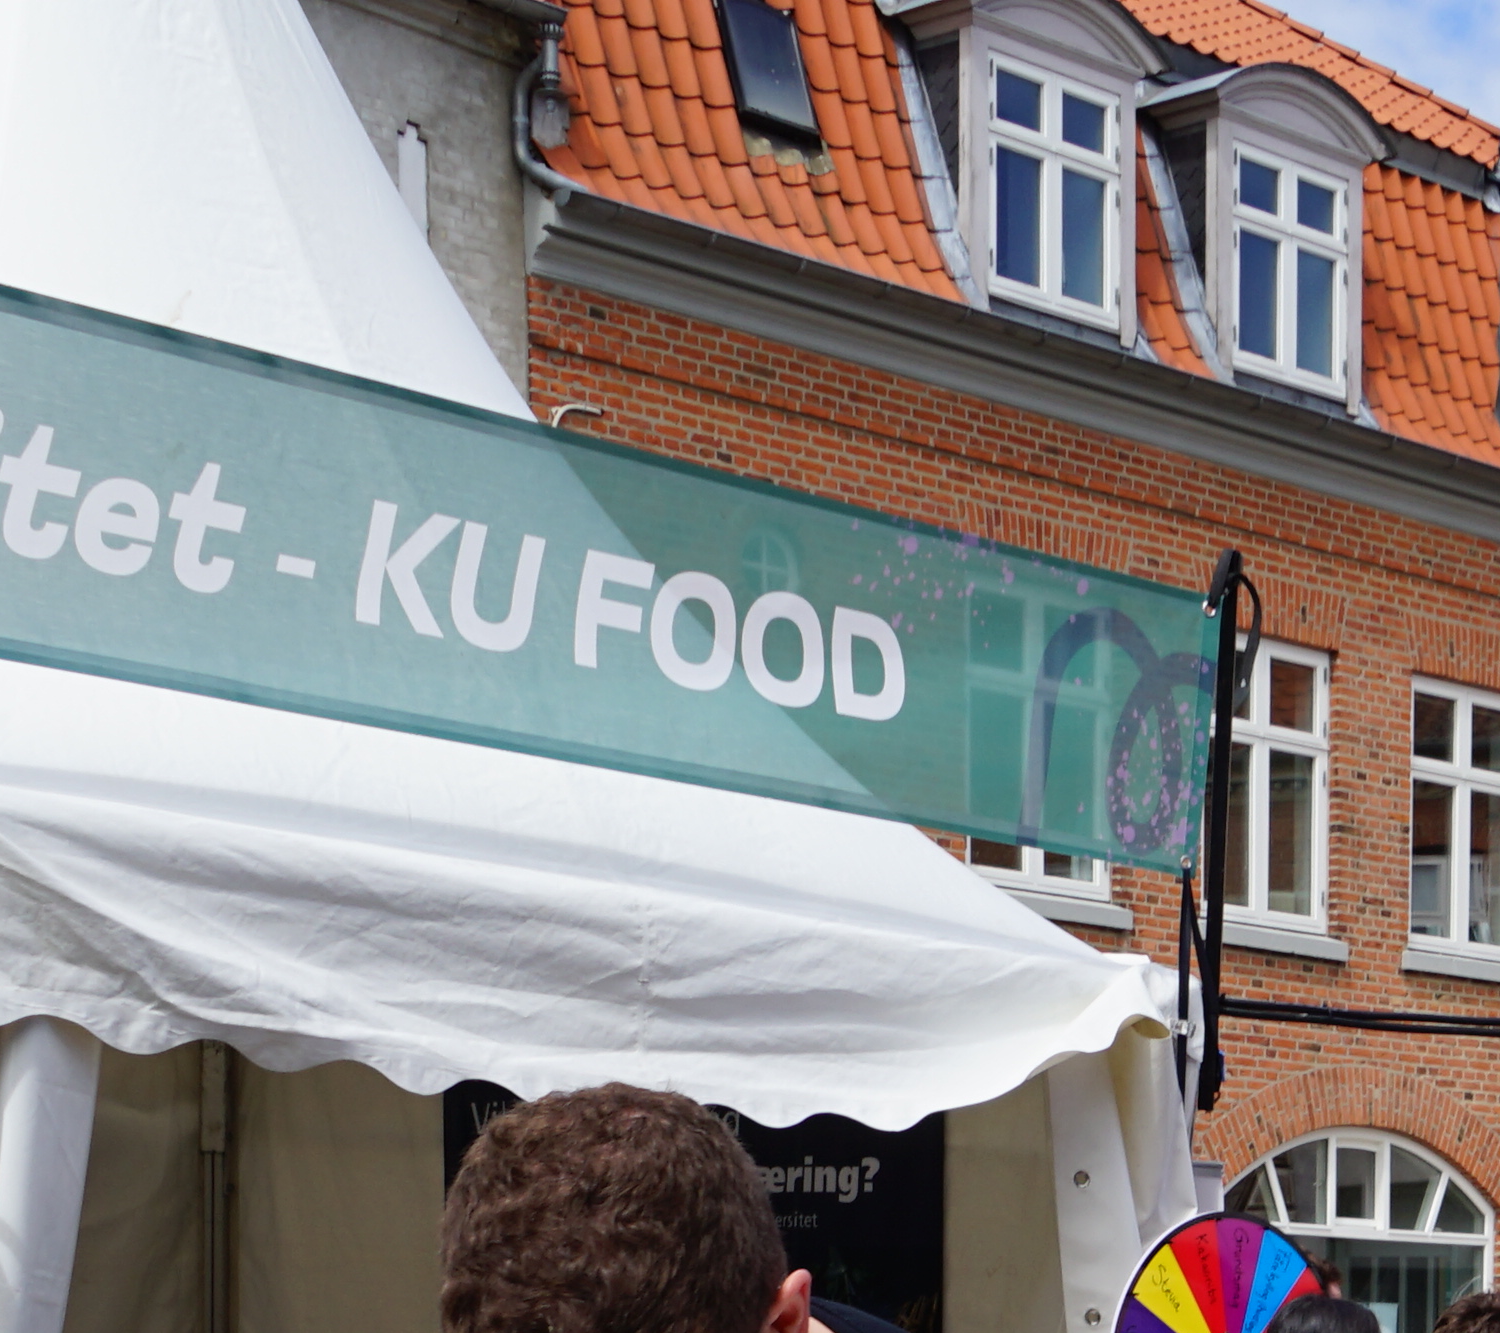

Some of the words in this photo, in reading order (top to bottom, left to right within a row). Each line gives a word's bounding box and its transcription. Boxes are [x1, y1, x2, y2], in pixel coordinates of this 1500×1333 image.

[277, 552, 314, 579] -
[355, 499, 546, 653] KU
[573, 553, 906, 722] FOOD
[1151, 1263, 1182, 1314] Stevia
